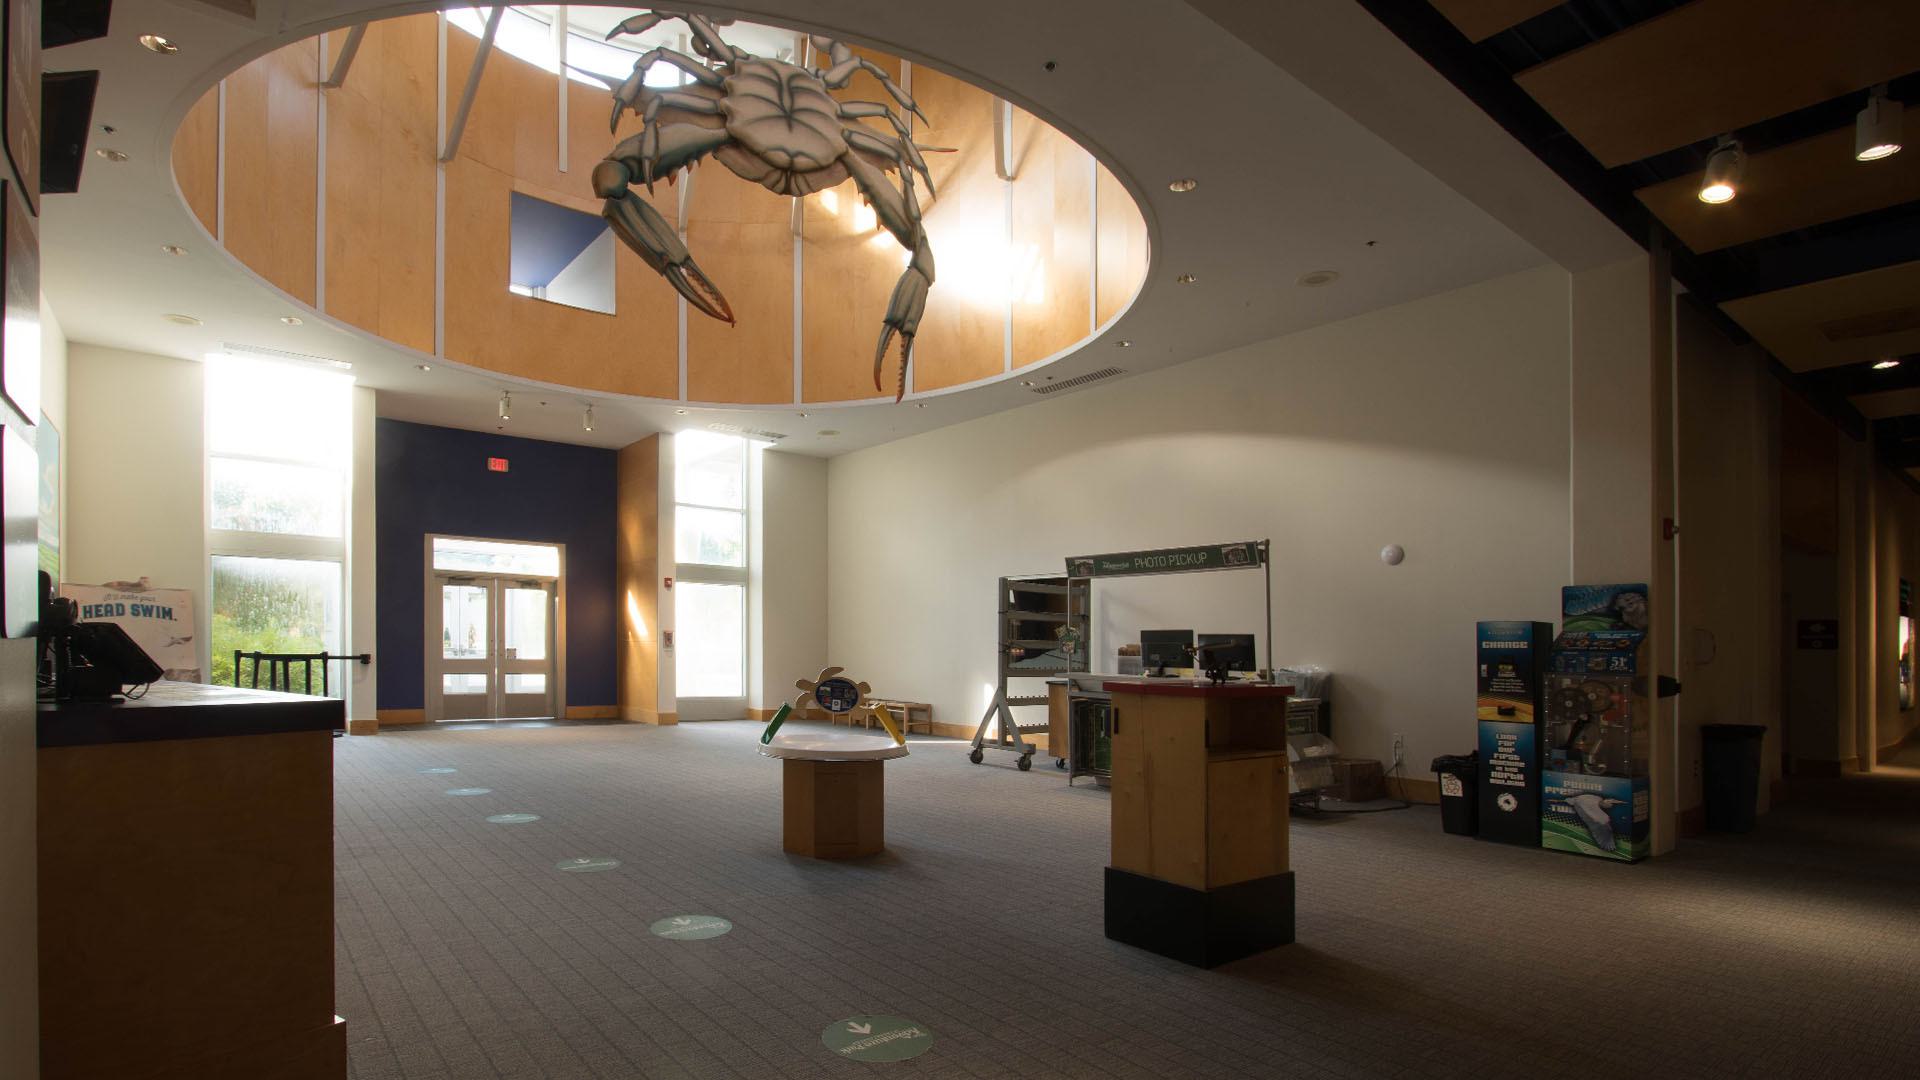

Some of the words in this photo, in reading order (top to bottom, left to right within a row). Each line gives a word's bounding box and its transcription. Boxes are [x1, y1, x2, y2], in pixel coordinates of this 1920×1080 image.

[1134, 555, 1166, 569] PHOTO
[1169, 551, 1207, 567] PICKUP
[82, 603, 126, 619] HEAD
